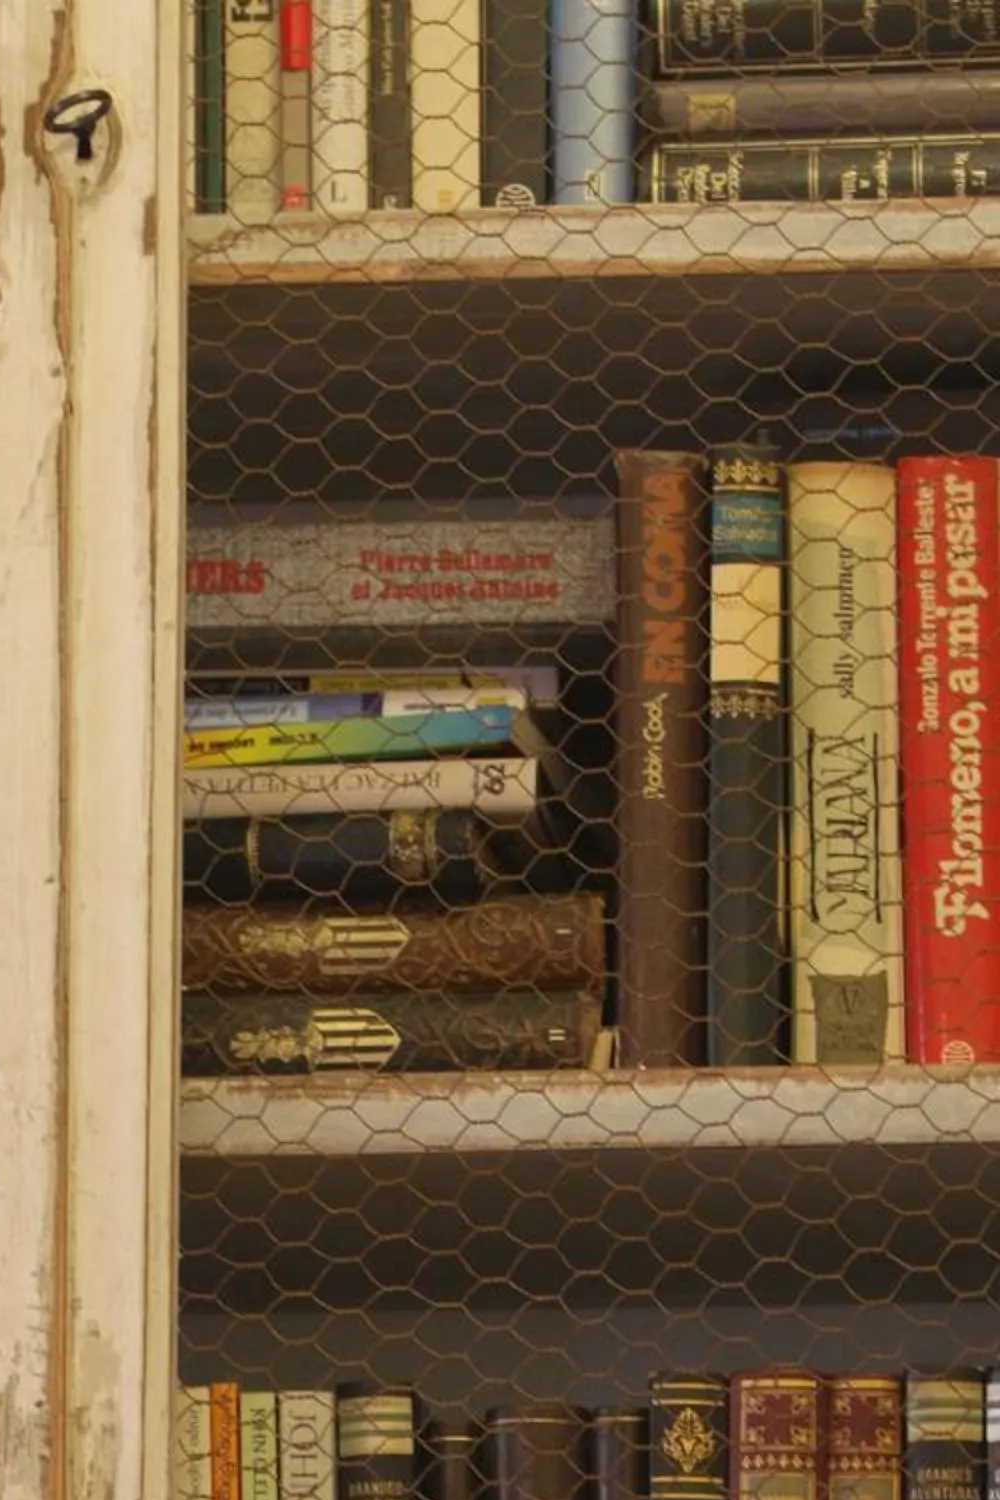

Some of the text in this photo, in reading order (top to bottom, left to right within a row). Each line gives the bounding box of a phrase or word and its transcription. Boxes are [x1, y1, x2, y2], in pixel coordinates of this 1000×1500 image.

[641, 471, 684, 686] EN COMA
[643, 692, 668, 742] Cook
[934, 472, 988, 937] Filomeno, a mi pesar
